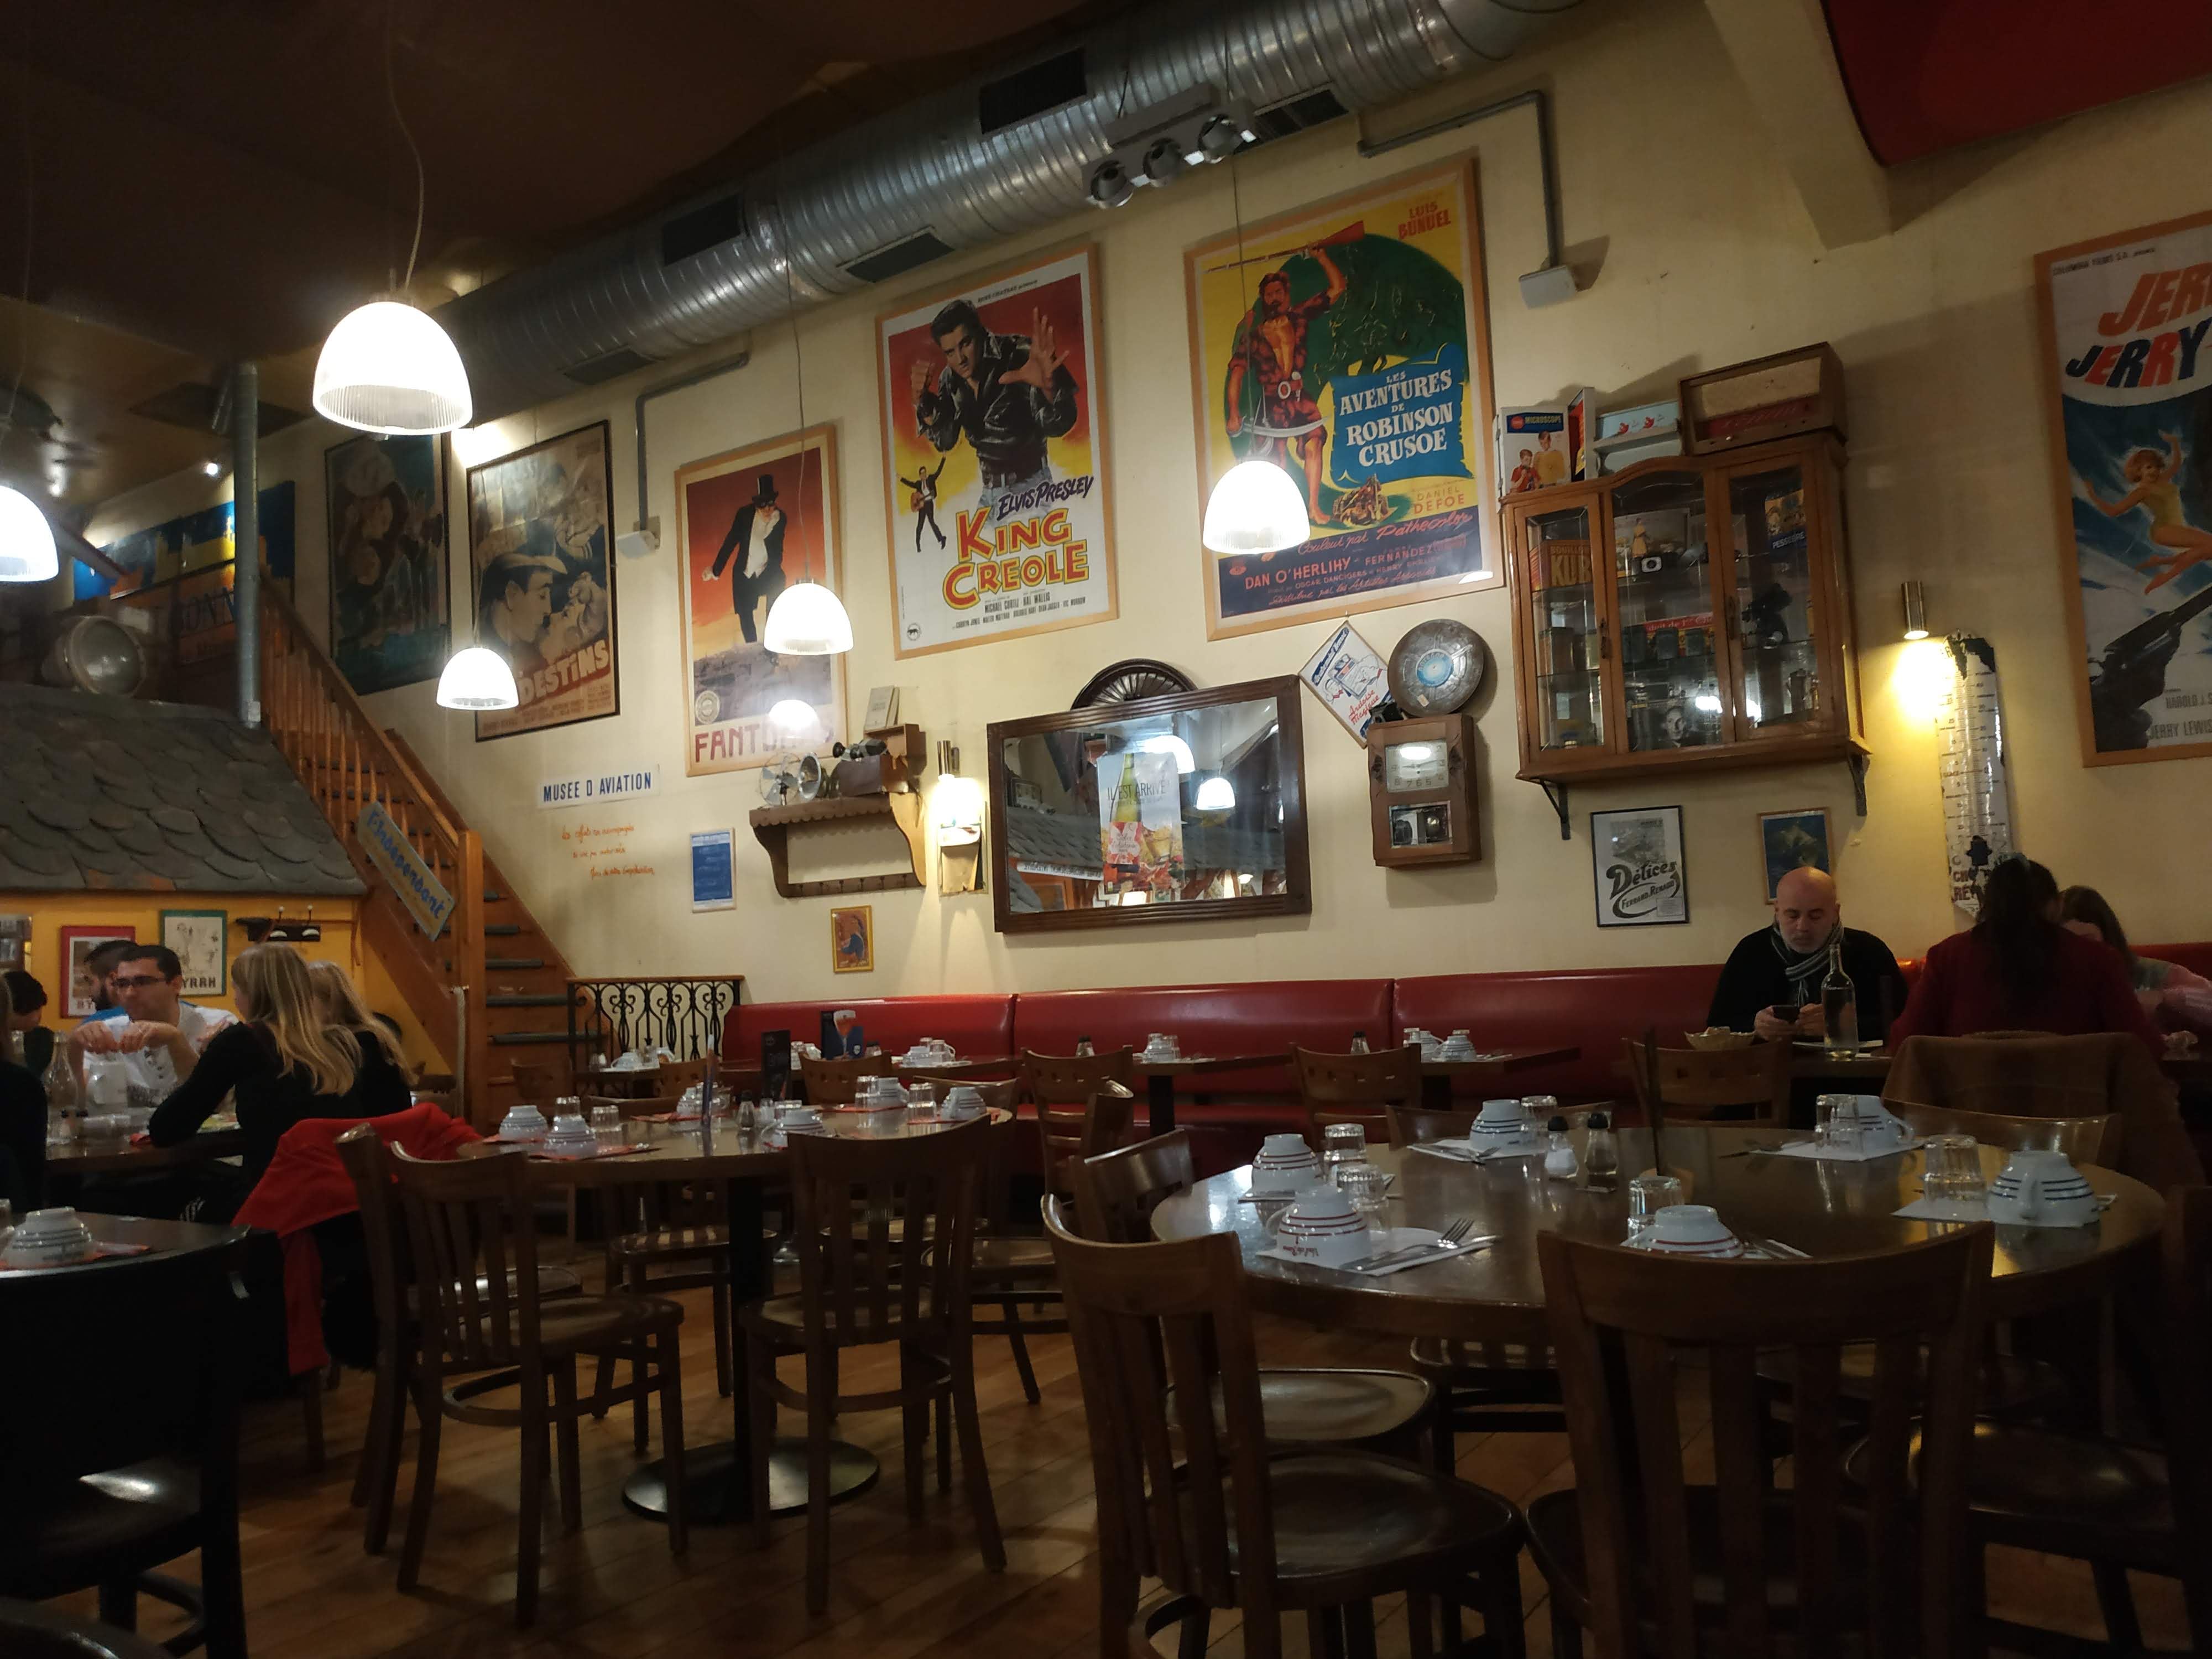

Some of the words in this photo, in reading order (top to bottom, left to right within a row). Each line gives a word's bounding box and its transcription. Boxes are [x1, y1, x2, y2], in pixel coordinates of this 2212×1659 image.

[2065, 316, 2212, 388] JERRY
[1386, 371, 1406, 383] LES
[1339, 369, 1453, 416] AVENTURES
[1391, 403, 1405, 413] DE
[1346, 402, 1453, 446] ROBINSON
[1359, 427, 1447, 467] CRUSOE
[997, 488, 1036, 521] ELVIS
[1035, 476, 1094, 509] PRESLEY
[1413, 494, 1465, 514] DEFOE
[1417, 485, 1460, 501] DANIEL
[956, 505, 1072, 563] KING
[942, 539, 1089, 610] CREOLE
[1245, 573, 1270, 590] DAN
[1275, 556, 1351, 583] O'HERLIHY
[1365, 544, 1433, 566] FERNANDEZ
[1034, 591, 1050, 603] WALLIS
[1349, 690, 1375, 717] Ardoise
[1351, 695, 1380, 725] Magique
[2183, 719, 2212, 736] LEWIS
[544, 781, 580, 802] MUSEE
[586, 780, 592, 796] D
[600, 773, 651, 795] AVIATION
[1118, 784, 1133, 800] EST
[1606, 860, 1677, 900] Délices
[181, 976, 216, 989] YRRH
